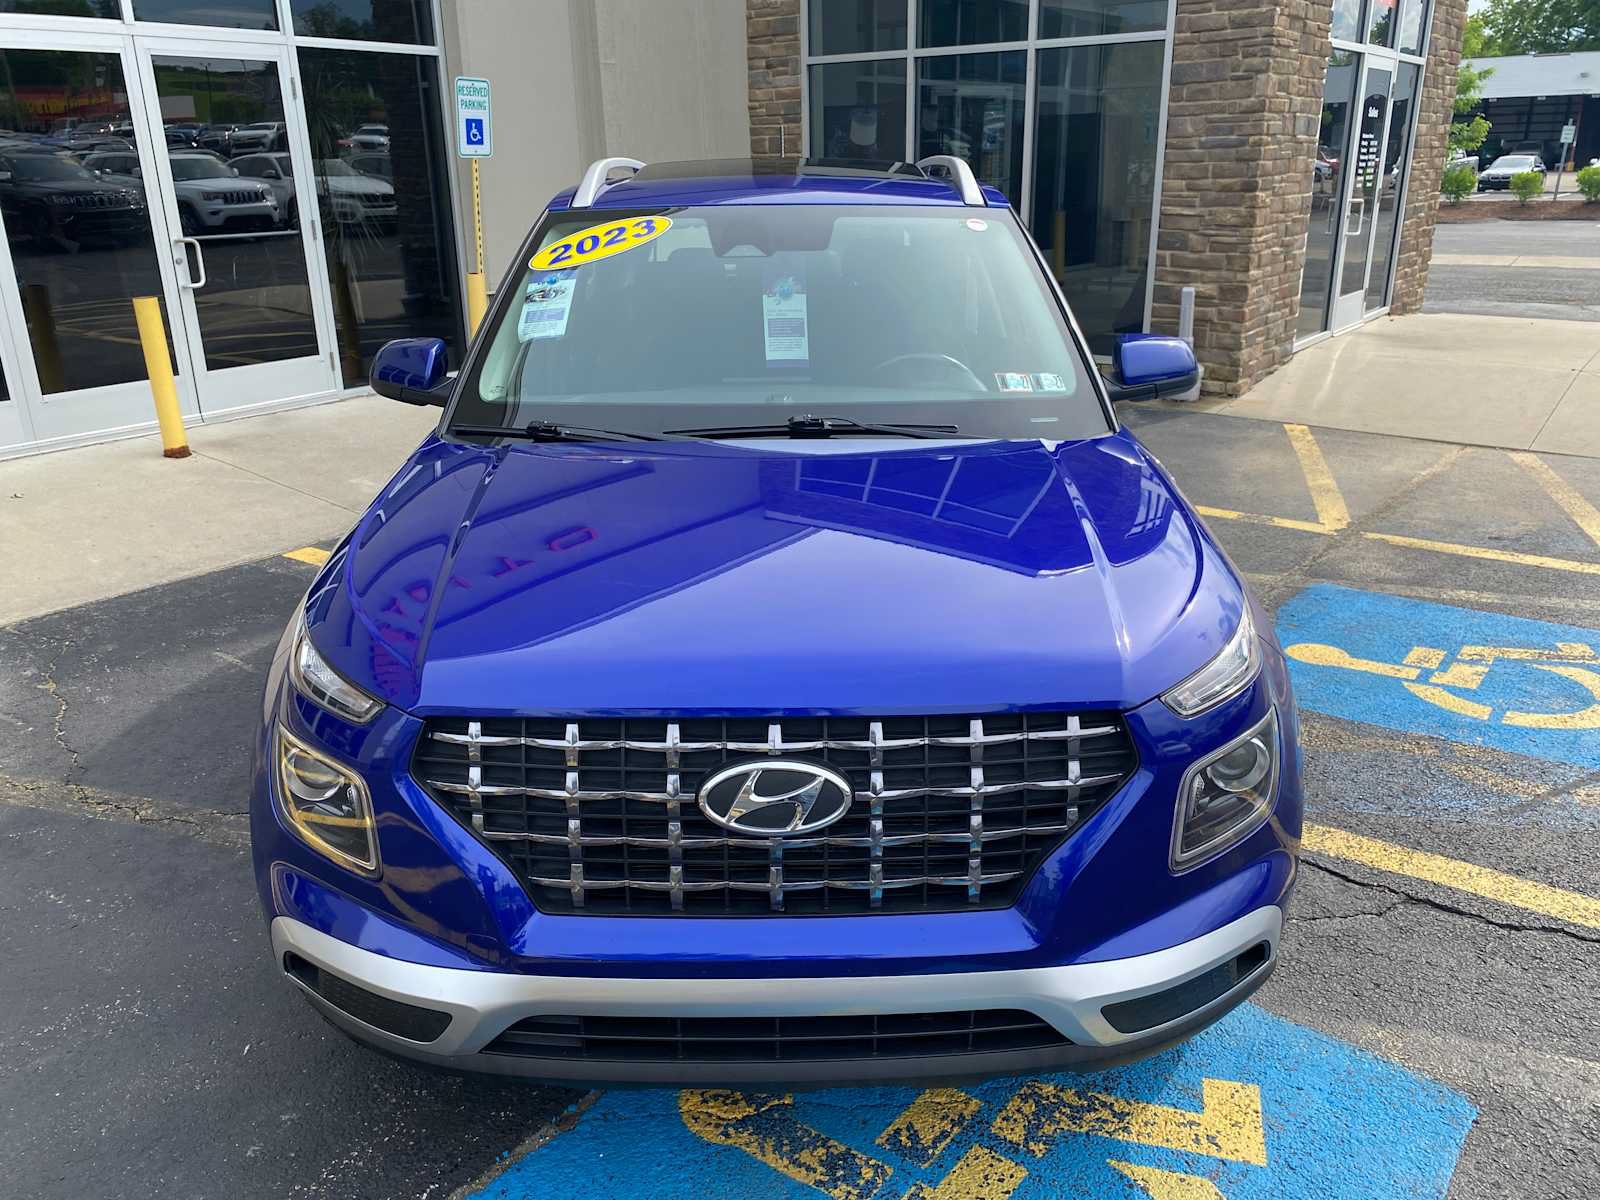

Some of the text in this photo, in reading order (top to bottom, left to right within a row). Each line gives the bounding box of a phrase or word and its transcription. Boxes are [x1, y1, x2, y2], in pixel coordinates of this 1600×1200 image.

[457, 86, 488, 97] RESERVED
[460, 99, 487, 111] PARKING
[548, 219, 657, 266] 2023
